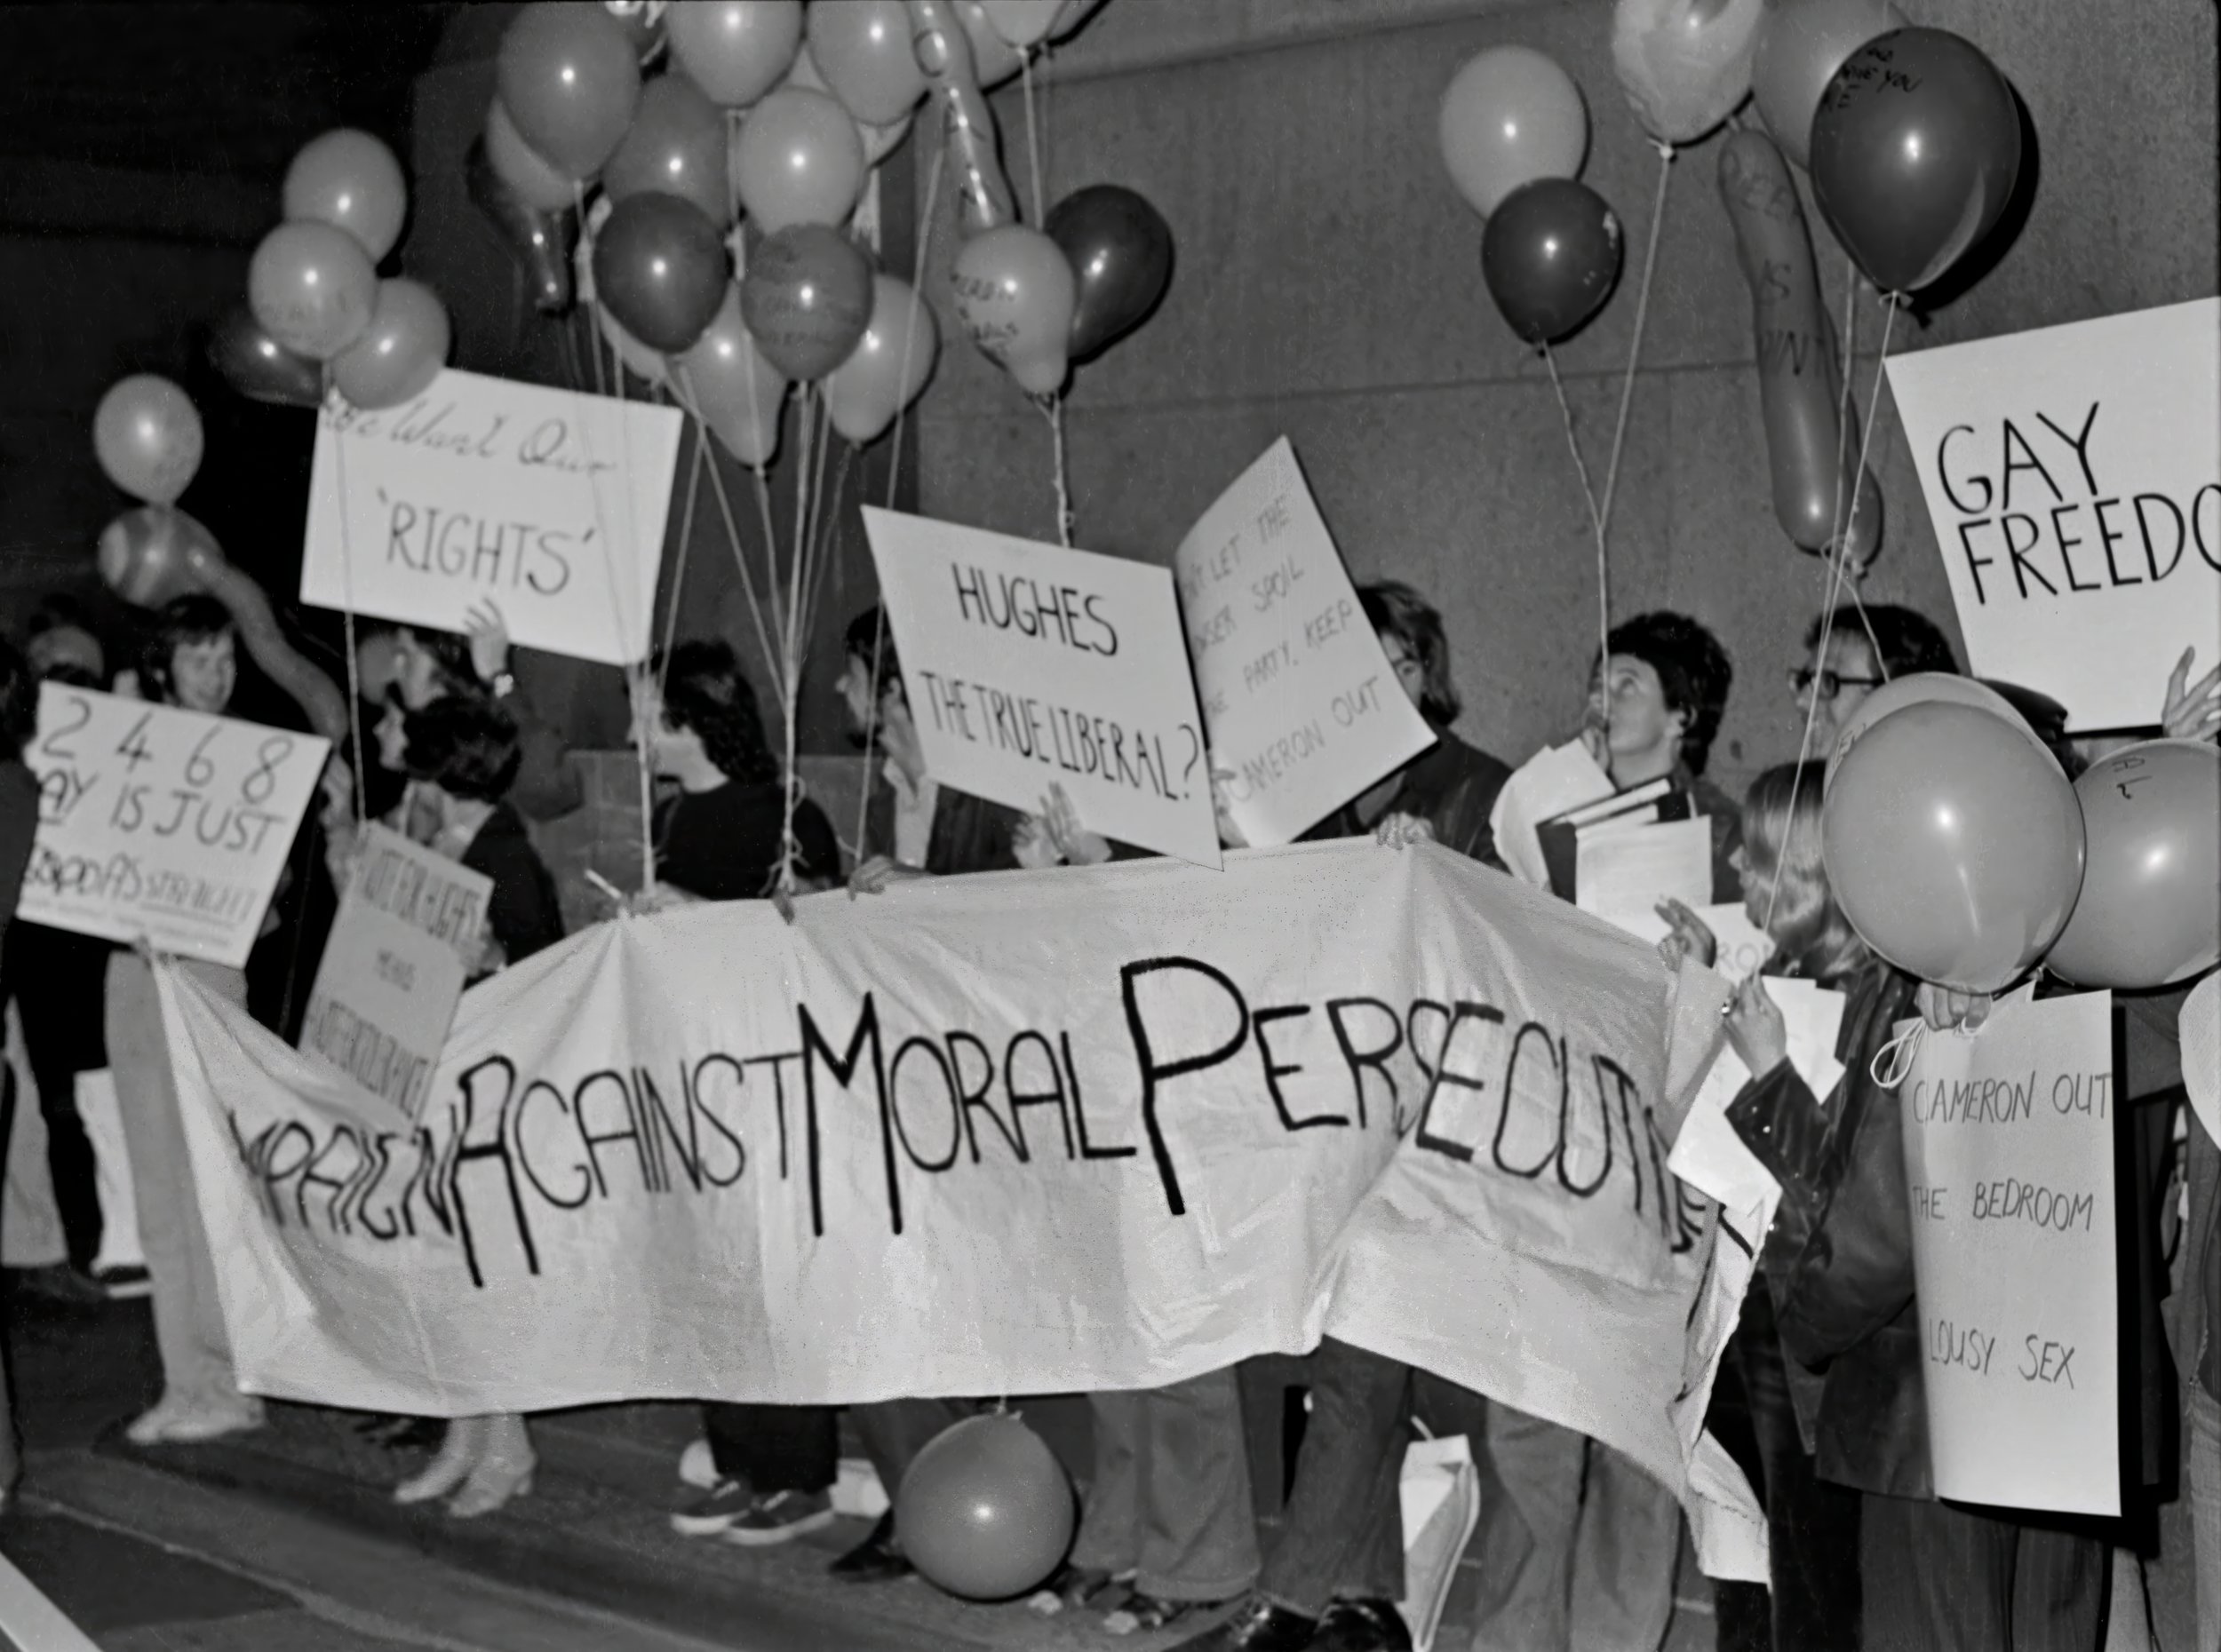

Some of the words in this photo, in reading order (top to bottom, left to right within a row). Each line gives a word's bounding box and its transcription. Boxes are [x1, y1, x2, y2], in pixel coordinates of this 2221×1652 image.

[1938, 401, 2100, 515] GAY
[1209, 535, 1244, 583] LET
[1256, 494, 1293, 544] THE
[1957, 483, 2221, 606] FREEDO
[952, 561, 1118, 657] HUGHES
[1192, 604, 1238, 659] OSER
[1250, 554, 1305, 614] SPOIL
[1303, 598, 1355, 650] KEEP
[919, 670, 976, 743] THE
[972, 684, 1052, 764] TRUE
[1048, 704, 1200, 801] LIBERAL?
[1330, 675, 1383, 728] OUT
[40, 695, 92, 761] 2
[115, 711, 154, 774] 4
[184, 721, 222, 789] 6
[241, 734, 295, 806] 8
[41, 767, 100, 815] AY
[110, 782, 154, 833] IS
[153, 785, 288, 857] JUST
[451, 1053, 803, 1288] AGAINST
[797, 990, 1137, 1236] MORAL
[1913, 1070, 2037, 1124] CAMERON
[2052, 1072, 2114, 1120] OUT
[1913, 1184, 1947, 1220] THE
[1972, 1178, 2095, 1233] BEDROOM
[1927, 1319, 1995, 1376] LOUSY
[2018, 1333, 2076, 1389] SEX
